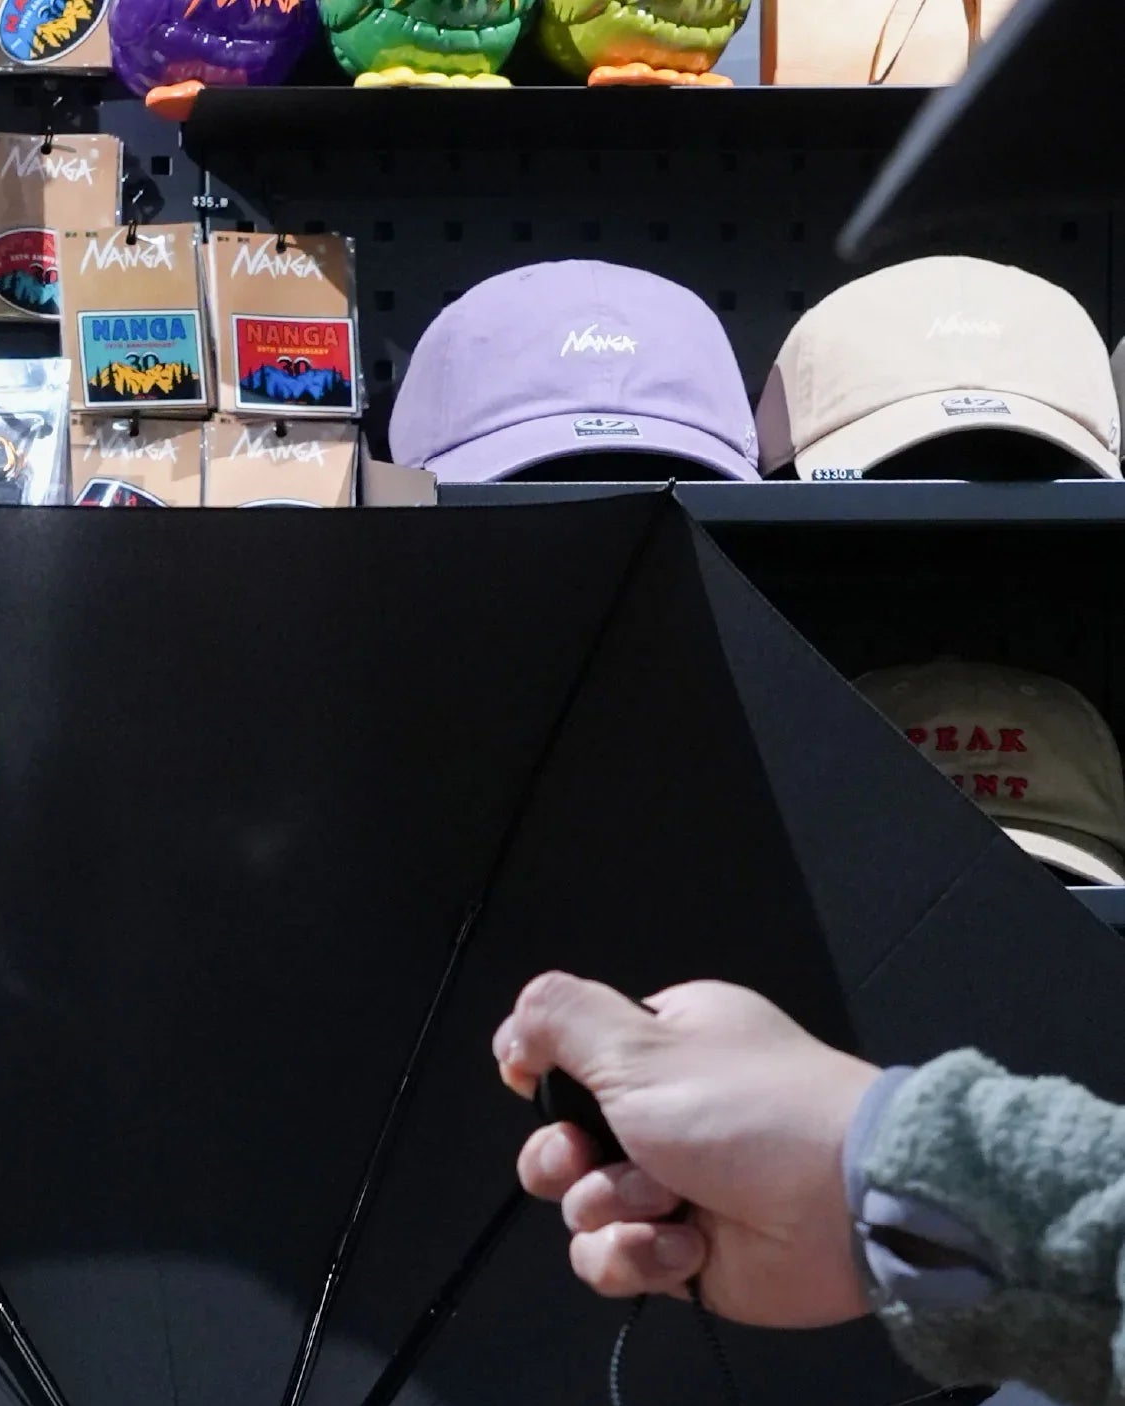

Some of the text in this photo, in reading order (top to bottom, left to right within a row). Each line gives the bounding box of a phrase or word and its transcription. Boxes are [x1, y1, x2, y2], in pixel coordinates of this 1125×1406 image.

[1, 139, 97, 186] NANGA
[79, 225, 174, 275] NANGA
[230, 233, 324, 281] NANGA
[91, 317, 188, 342] NANGA
[245, 323, 340, 347] NANGA
[907, 725, 1028, 753] PEAK
